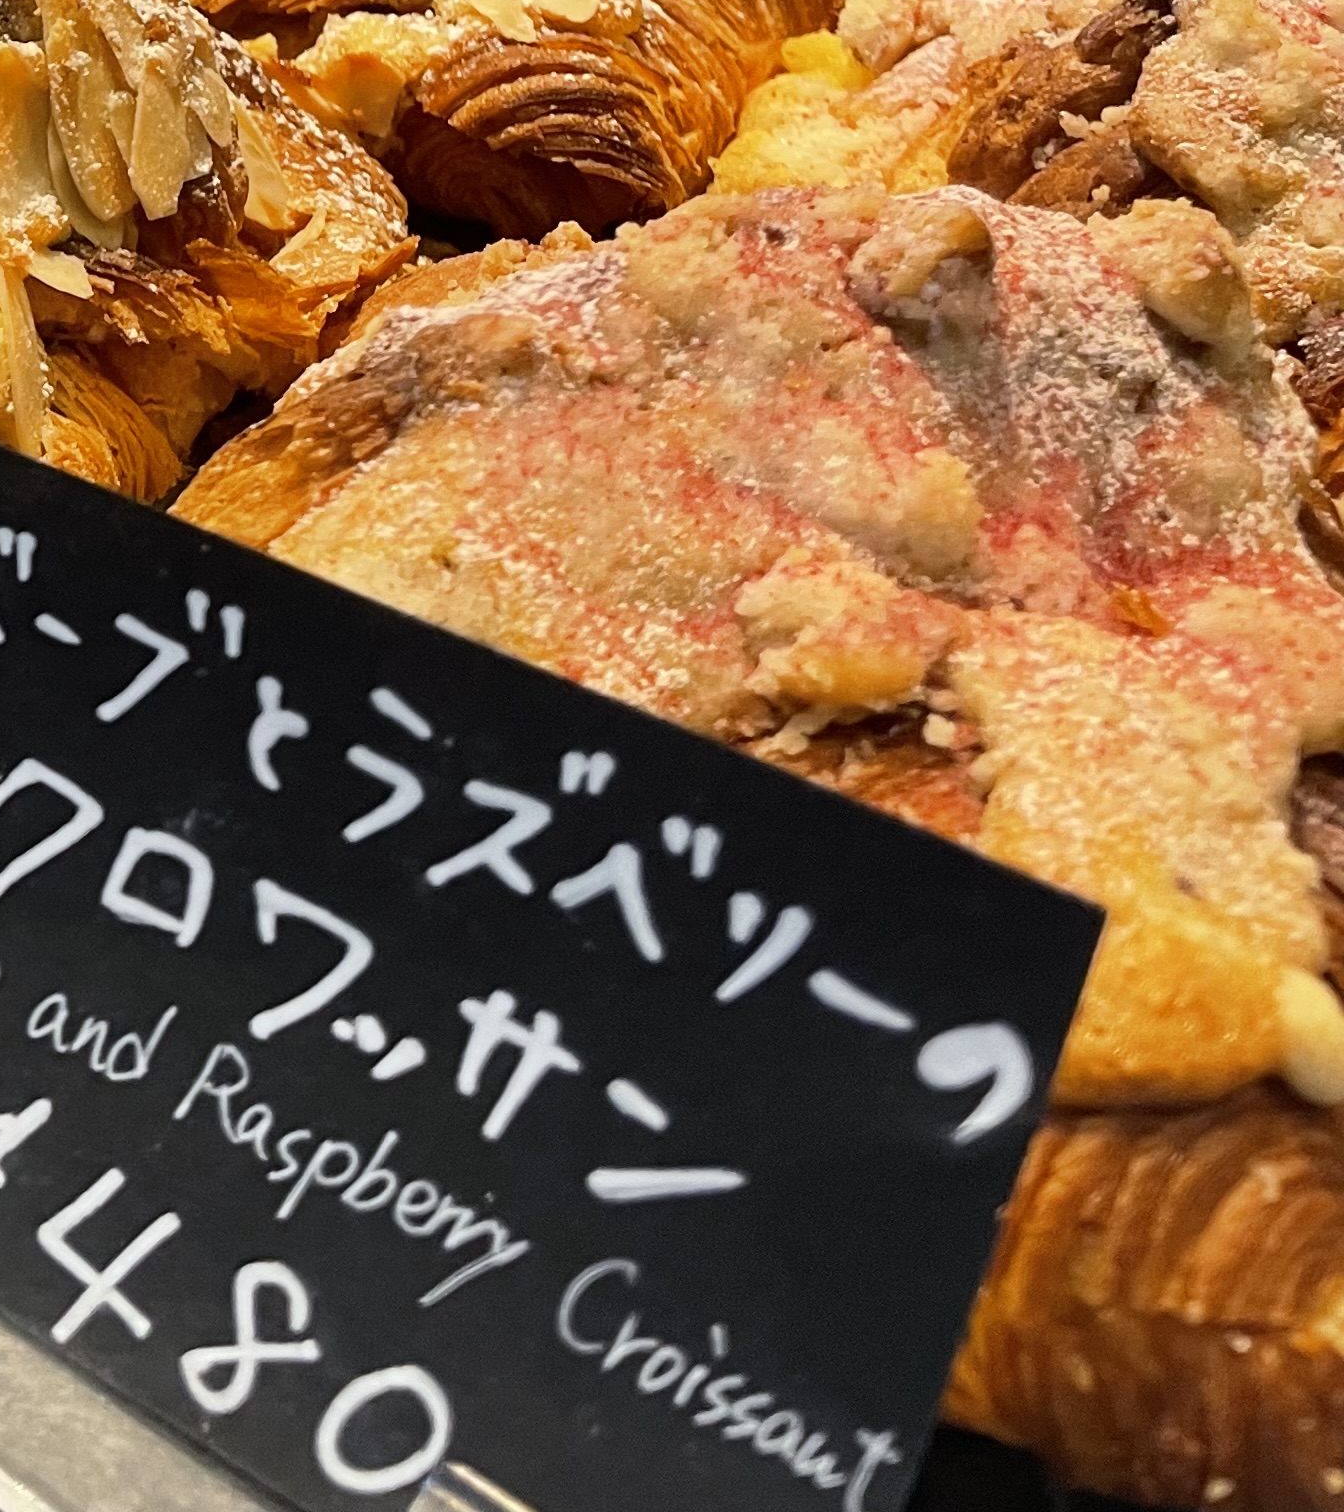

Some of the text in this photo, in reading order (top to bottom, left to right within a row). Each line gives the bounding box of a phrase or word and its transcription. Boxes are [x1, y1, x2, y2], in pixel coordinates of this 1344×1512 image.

[26, 993, 178, 1082] and
[173, 1042, 532, 1307] Raspberry
[555, 1257, 904, 1512] Croissant
